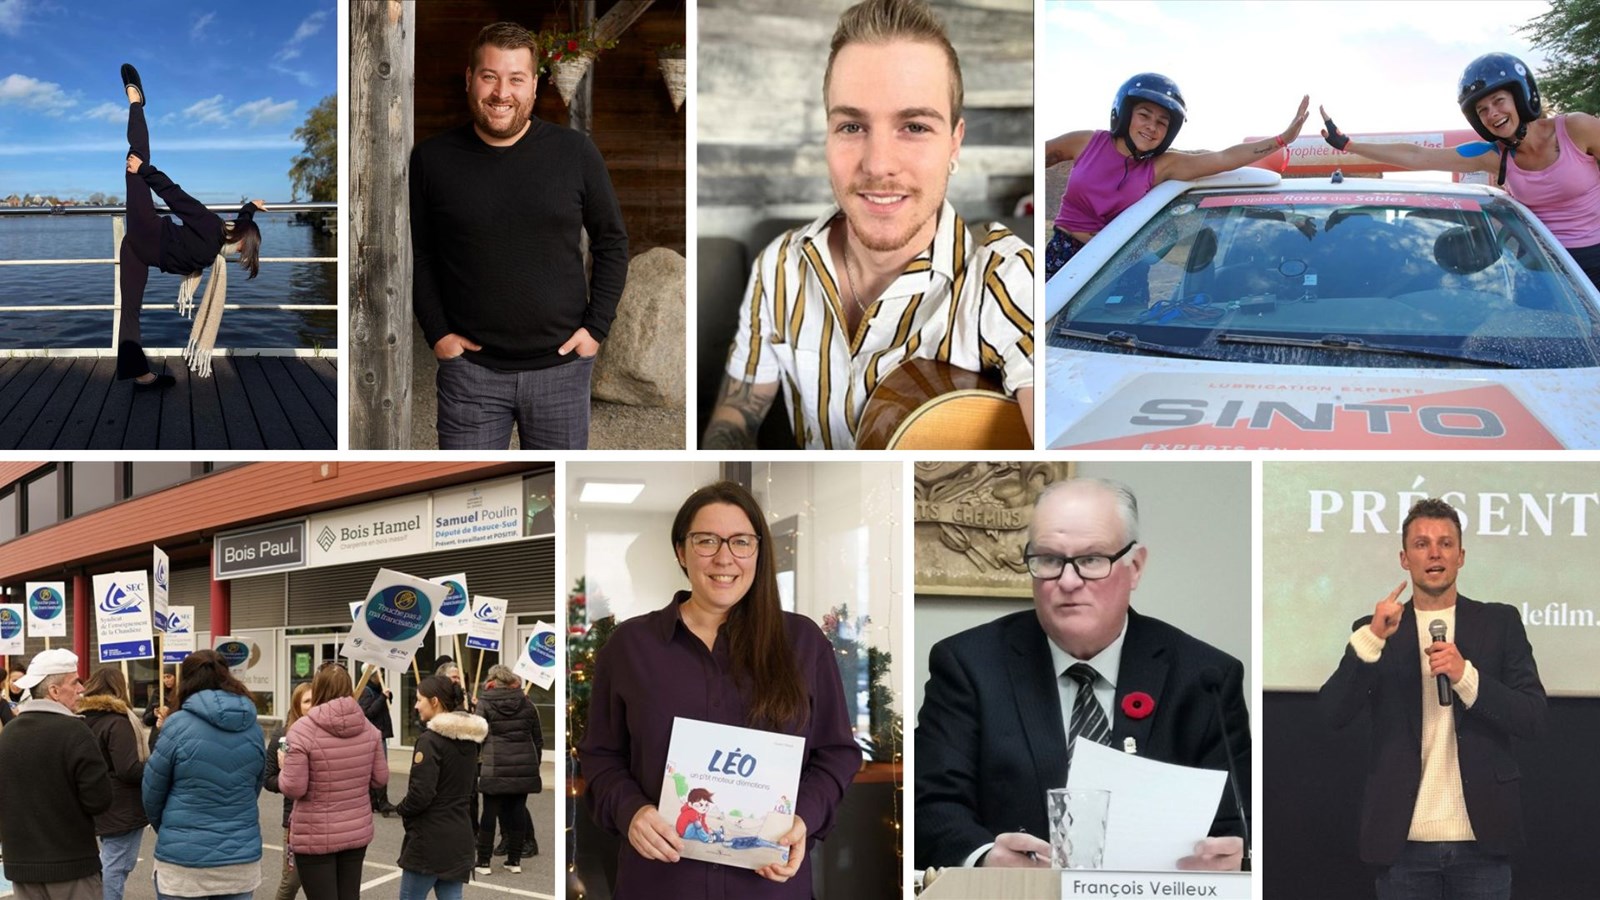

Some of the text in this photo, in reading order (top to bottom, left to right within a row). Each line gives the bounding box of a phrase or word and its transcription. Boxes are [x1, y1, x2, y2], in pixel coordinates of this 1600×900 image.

[1287, 145, 1329, 158] rophée
[1283, 194, 1327, 202] Roses
[1354, 194, 1406, 203] Sables
[1208, 383, 1333, 391] LUBRICATION
[1130, 398, 1507, 439] SINTO
[436, 506, 518, 528] Samuel Poulin
[914, 503, 1021, 528] TS CHEMINS
[340, 515, 420, 541] Bois Hamel
[436, 520, 517, 538] Député de Beauce-Sud
[225, 537, 293, 563] Bois Paul
[126, 583, 144, 592] SEC
[368, 610, 380, 618] ma
[378, 603, 403, 616] Touche
[404, 612, 417, 620] pas
[708, 747, 757, 778] LÉO
[712, 776, 734, 785] moteur
[1073, 880, 1217, 898] François Veilleux
